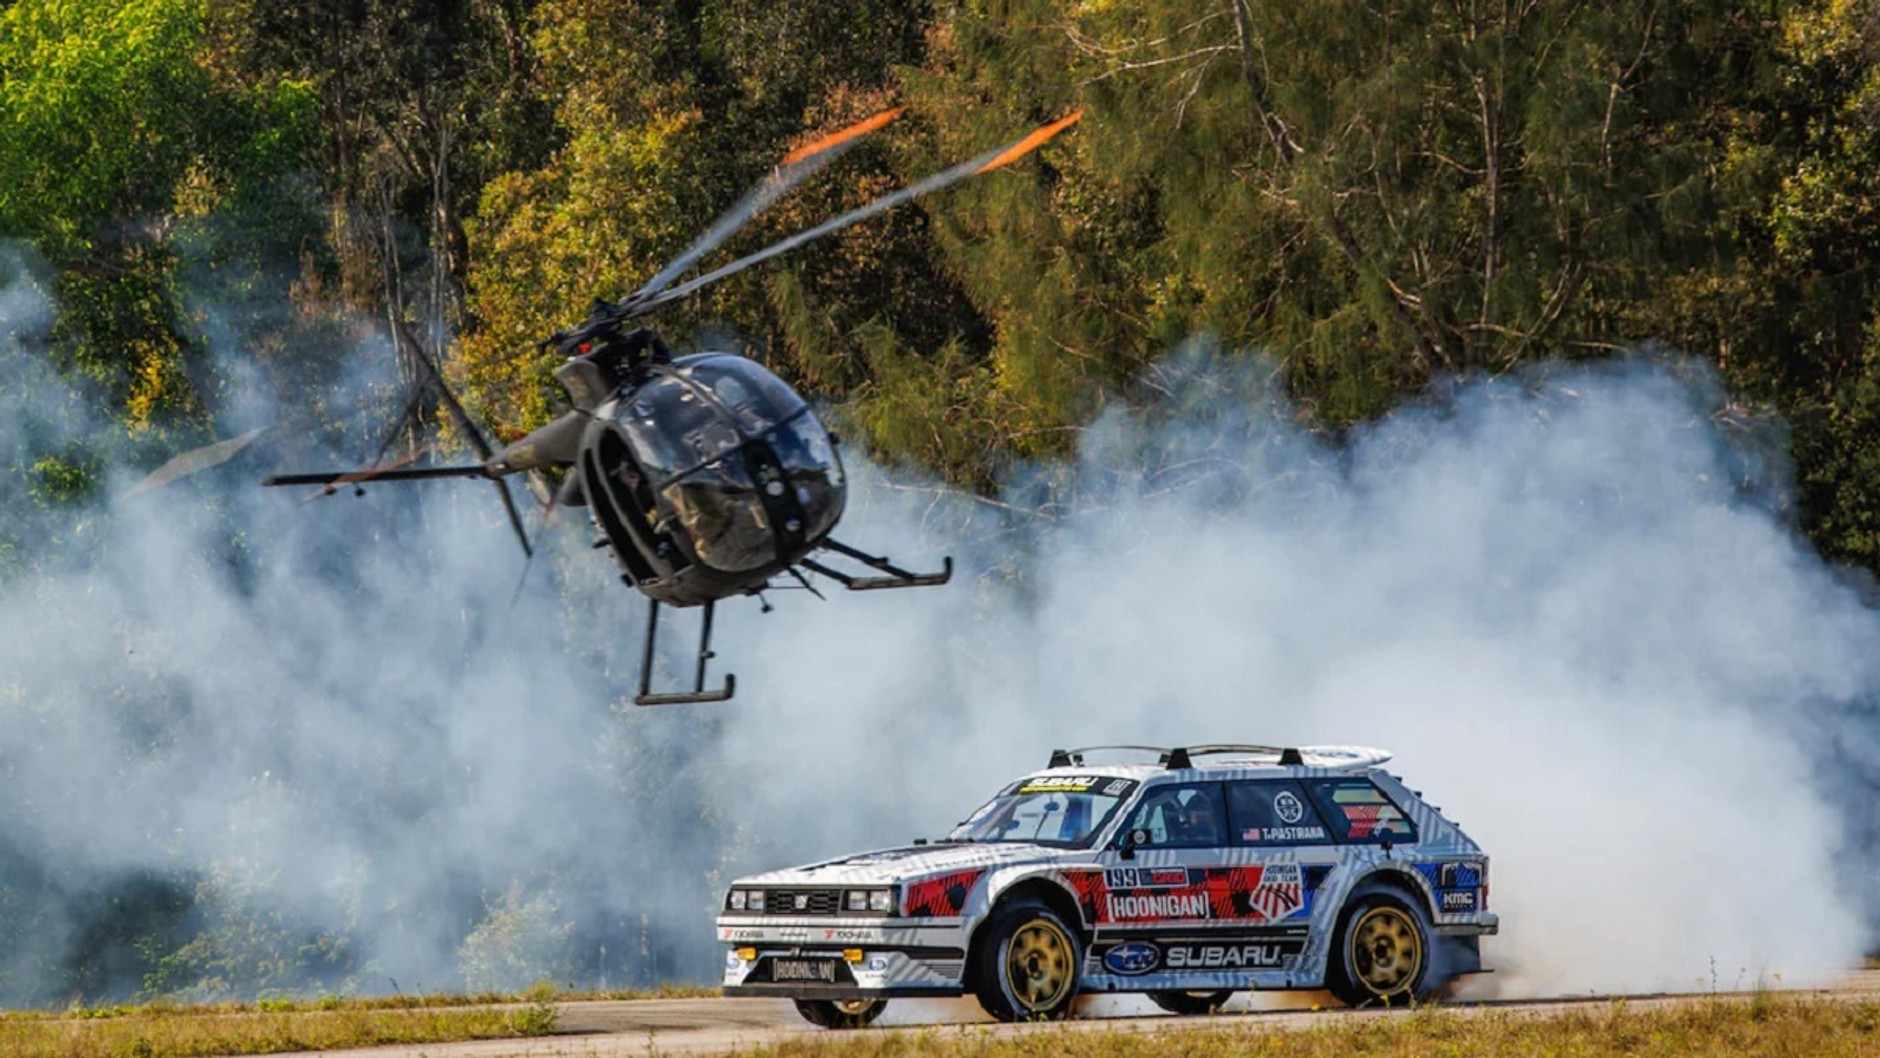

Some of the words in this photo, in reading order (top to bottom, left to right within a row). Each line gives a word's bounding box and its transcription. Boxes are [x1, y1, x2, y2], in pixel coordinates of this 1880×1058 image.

[1027, 777, 1099, 787] SUBARU
[1105, 868, 1138, 887] 199
[1166, 945, 1282, 967] SUBARU
